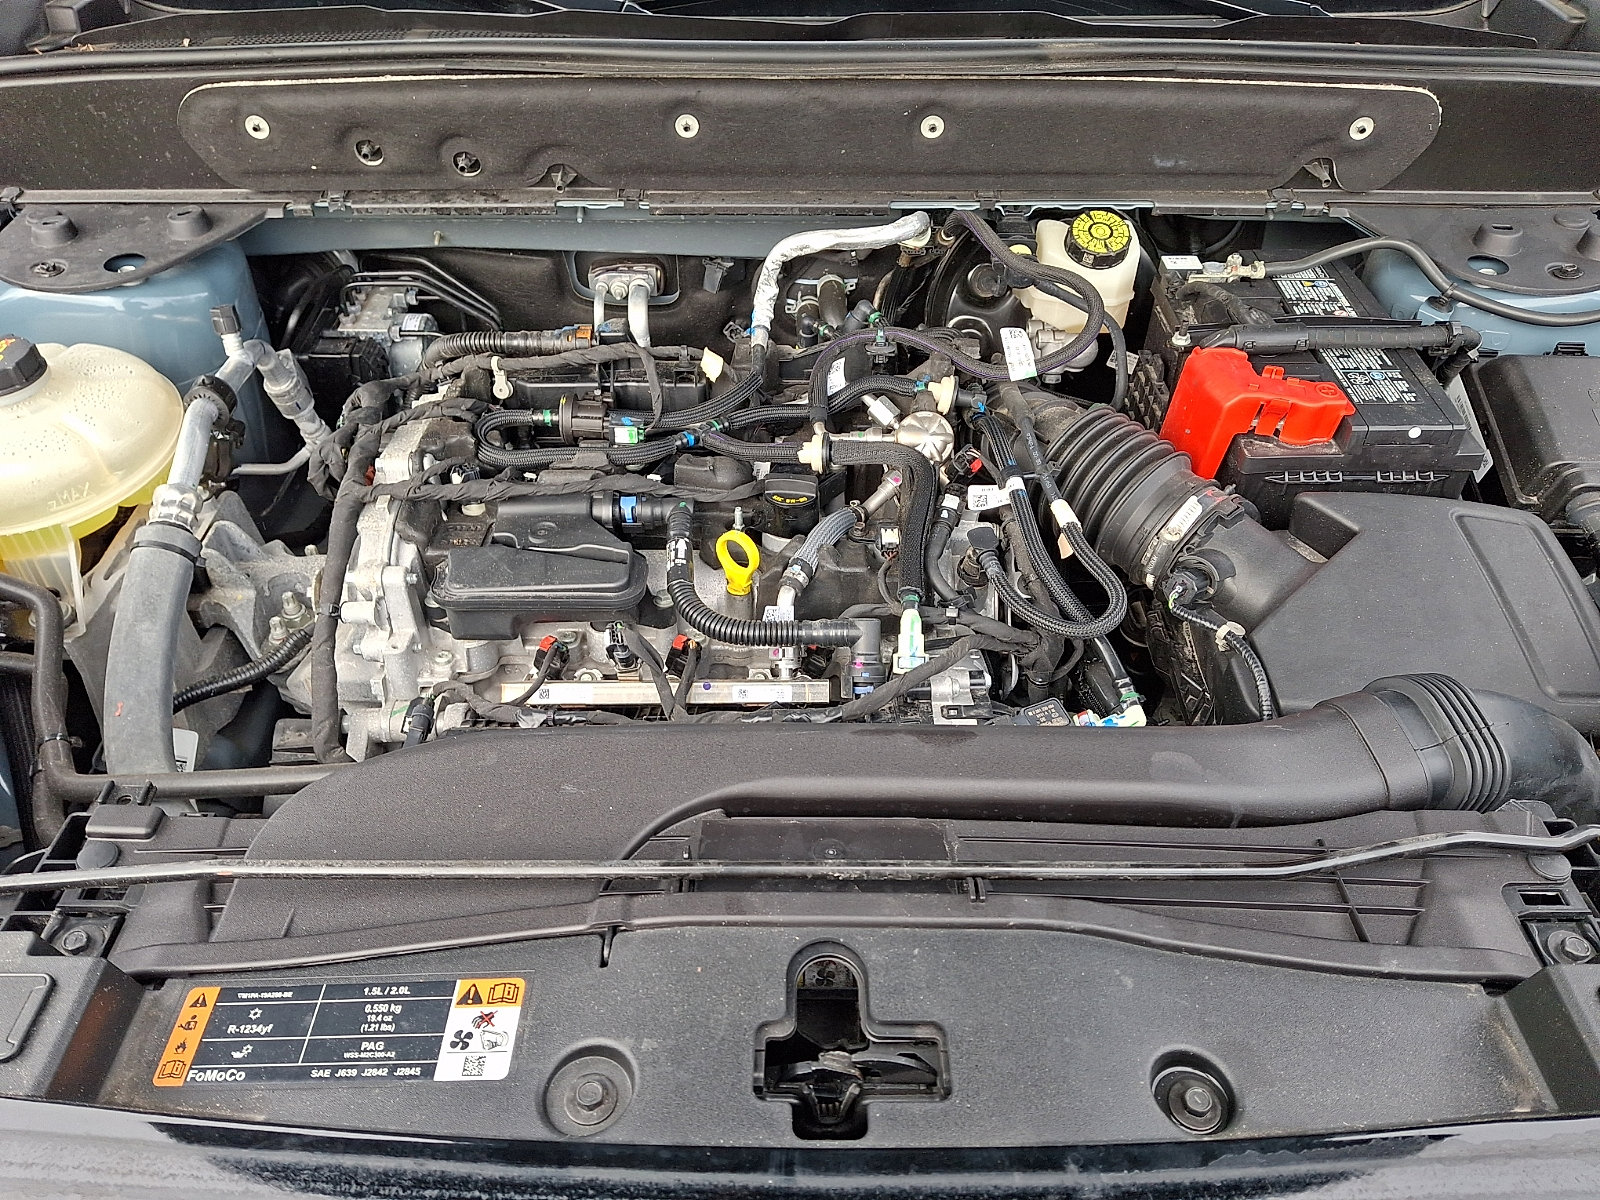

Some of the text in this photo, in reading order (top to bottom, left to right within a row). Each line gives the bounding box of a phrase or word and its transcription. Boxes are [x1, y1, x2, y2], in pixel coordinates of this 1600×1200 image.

[363, 986, 383, 996] 1.5L
[390, 985, 411, 995] 2.0L
[364, 1003, 403, 1015] 0.550 kg
[366, 1014, 394, 1022] 19.4 oz
[227, 1023, 274, 1036] R-1234yf
[360, 1023, 396, 1034] (1.21 lbs)
[360, 1041, 385, 1051] PAG
[186, 1068, 246, 1082] FoMoCo
[310, 1066, 422, 1078] SAE J639 J2842 J2845
